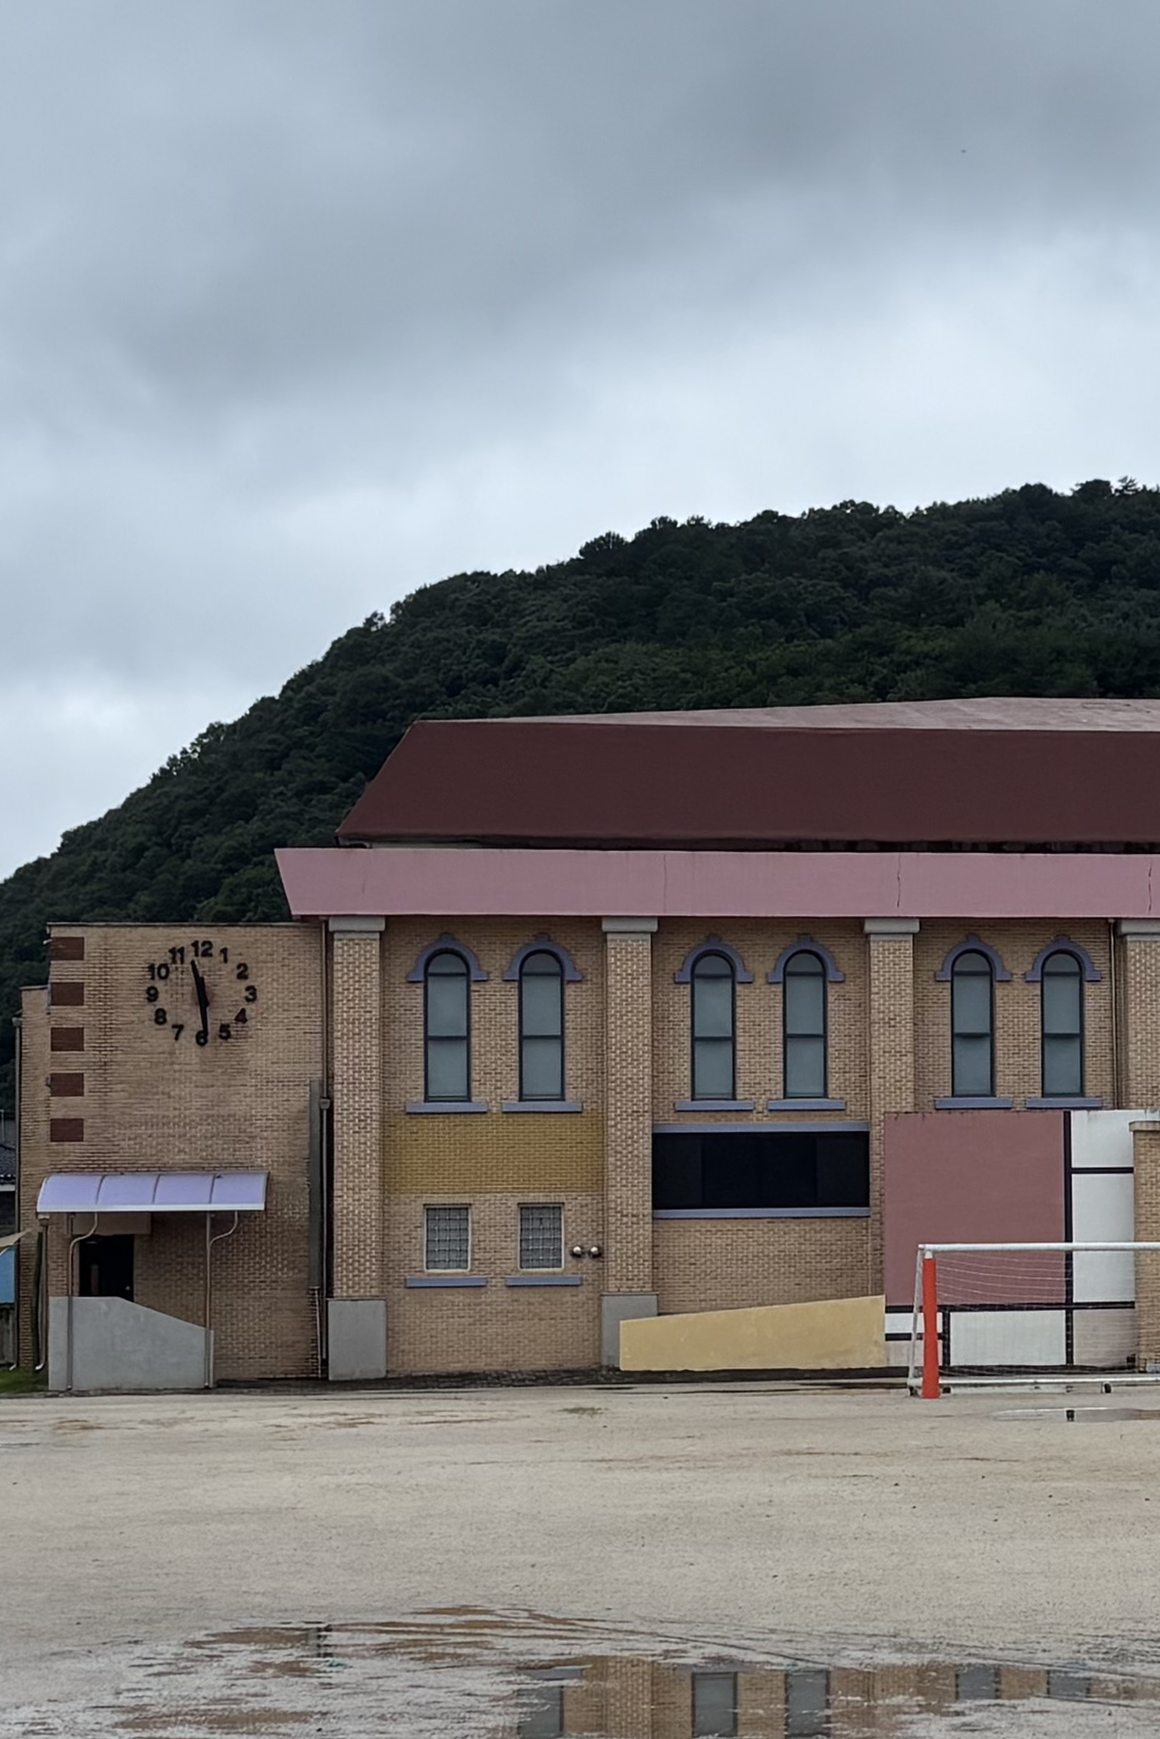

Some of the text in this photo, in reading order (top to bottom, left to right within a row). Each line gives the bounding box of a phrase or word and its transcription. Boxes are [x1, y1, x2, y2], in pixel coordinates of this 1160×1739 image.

[168, 947, 185, 964] 11
[190, 940, 213, 957] 12
[220, 947, 228, 964] 1
[147, 963, 169, 980] 10
[236, 962, 249, 980] 2
[146, 986, 159, 1003] 9
[245, 985, 257, 1003] 3
[154, 1008, 167, 1025] 8
[234, 1007, 248, 1024] 4
[171, 1024, 184, 1041] 7
[196, 1030, 208, 1047] 6
[219, 1024, 231, 1040] 5
